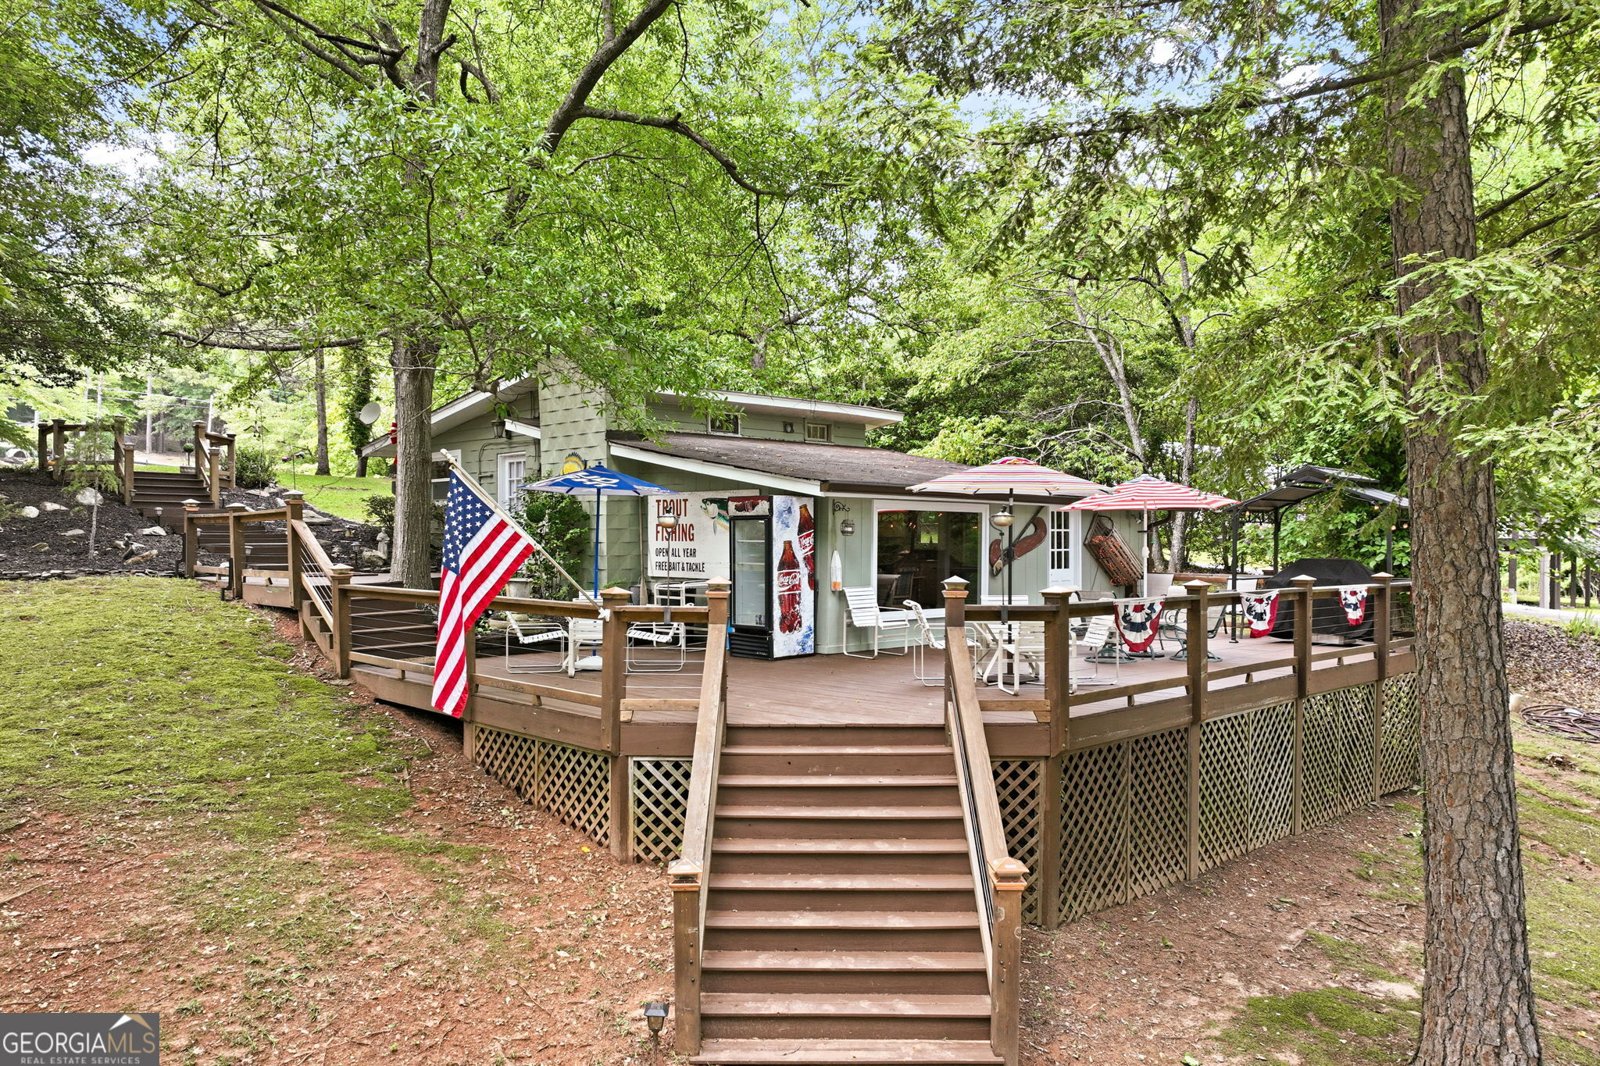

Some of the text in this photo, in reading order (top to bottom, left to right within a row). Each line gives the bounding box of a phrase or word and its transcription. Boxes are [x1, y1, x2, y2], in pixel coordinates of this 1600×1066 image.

[655, 499, 688, 517] TROUT
[655, 523, 695, 541] FISHING
[655, 548, 697, 557] OPEN ALL YEAR
[655, 562, 705, 572] FREE BAIT & TACKLE
